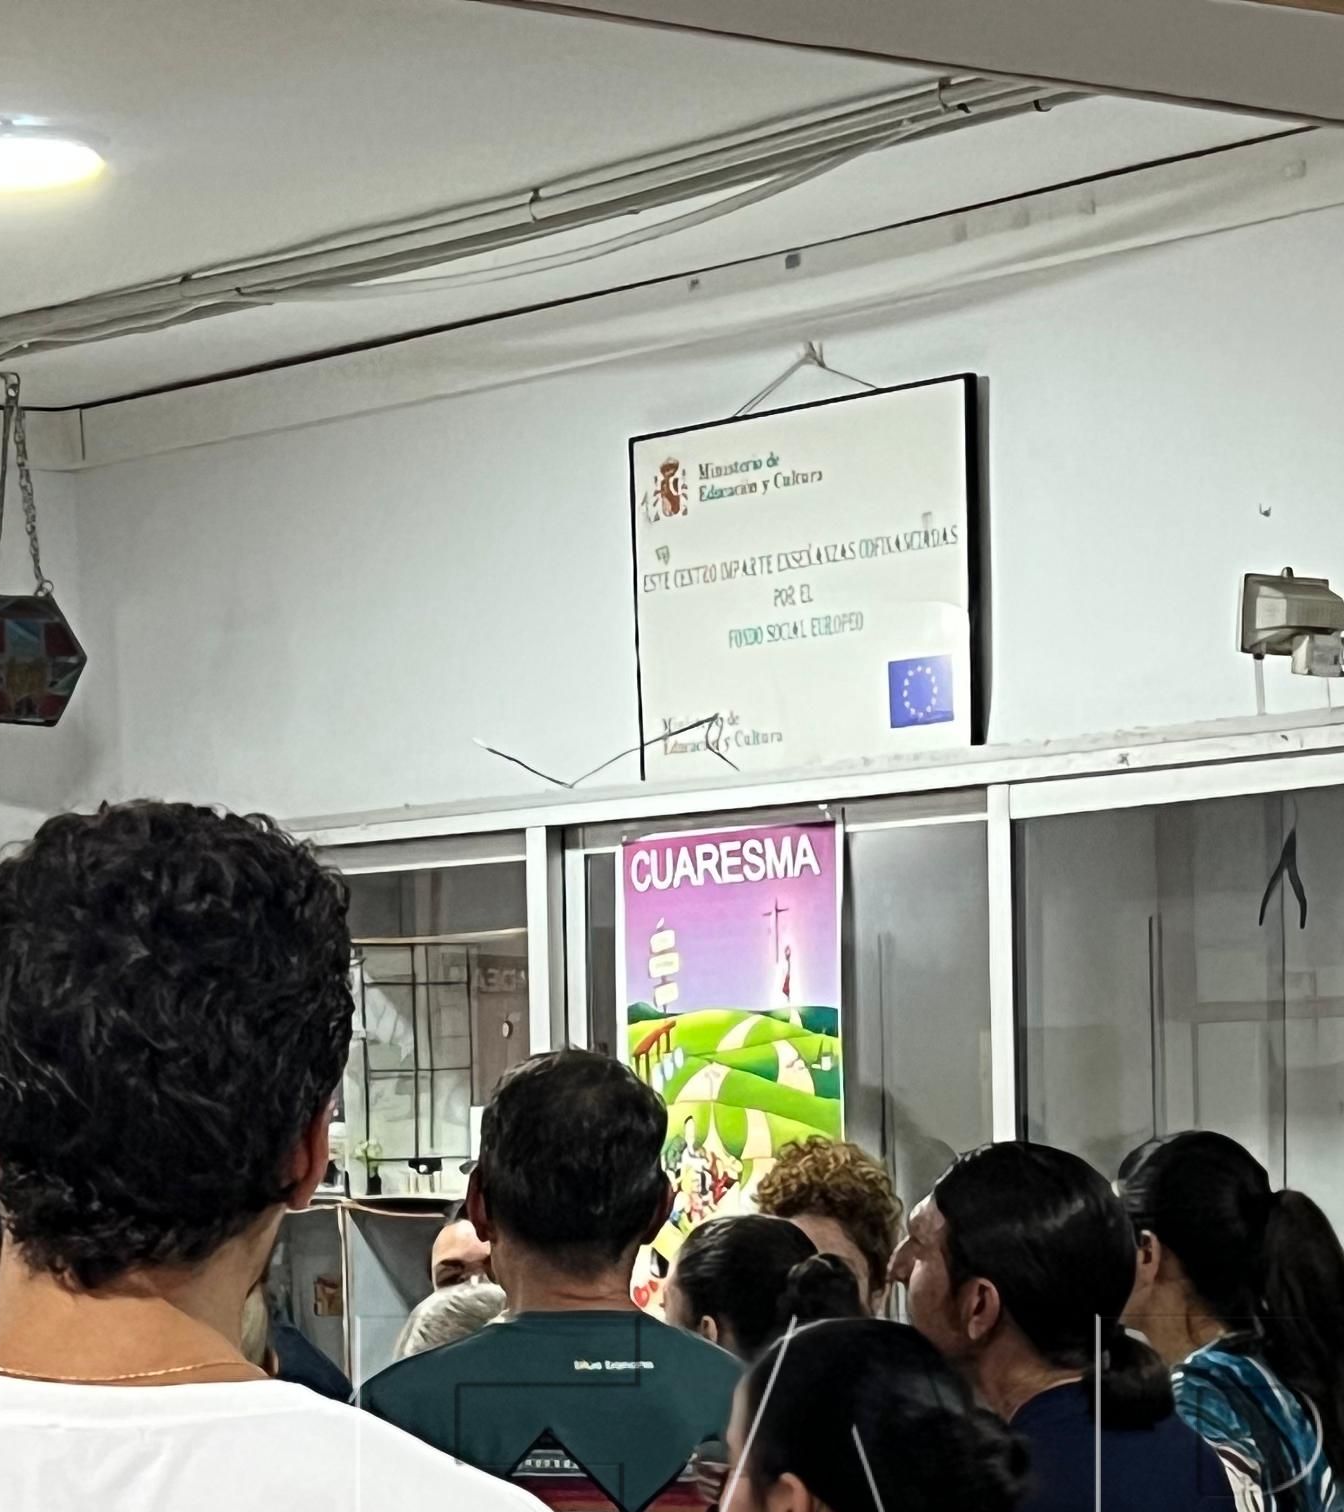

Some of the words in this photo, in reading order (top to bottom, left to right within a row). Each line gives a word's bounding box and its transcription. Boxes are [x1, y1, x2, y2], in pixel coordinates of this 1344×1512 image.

[762, 479, 770, 495] y
[774, 470, 823, 488] Cultura
[643, 571, 670, 592] ESTE
[773, 585, 796, 607] POR
[800, 583, 814, 603] EL
[630, 833, 821, 893] CUARESMA
